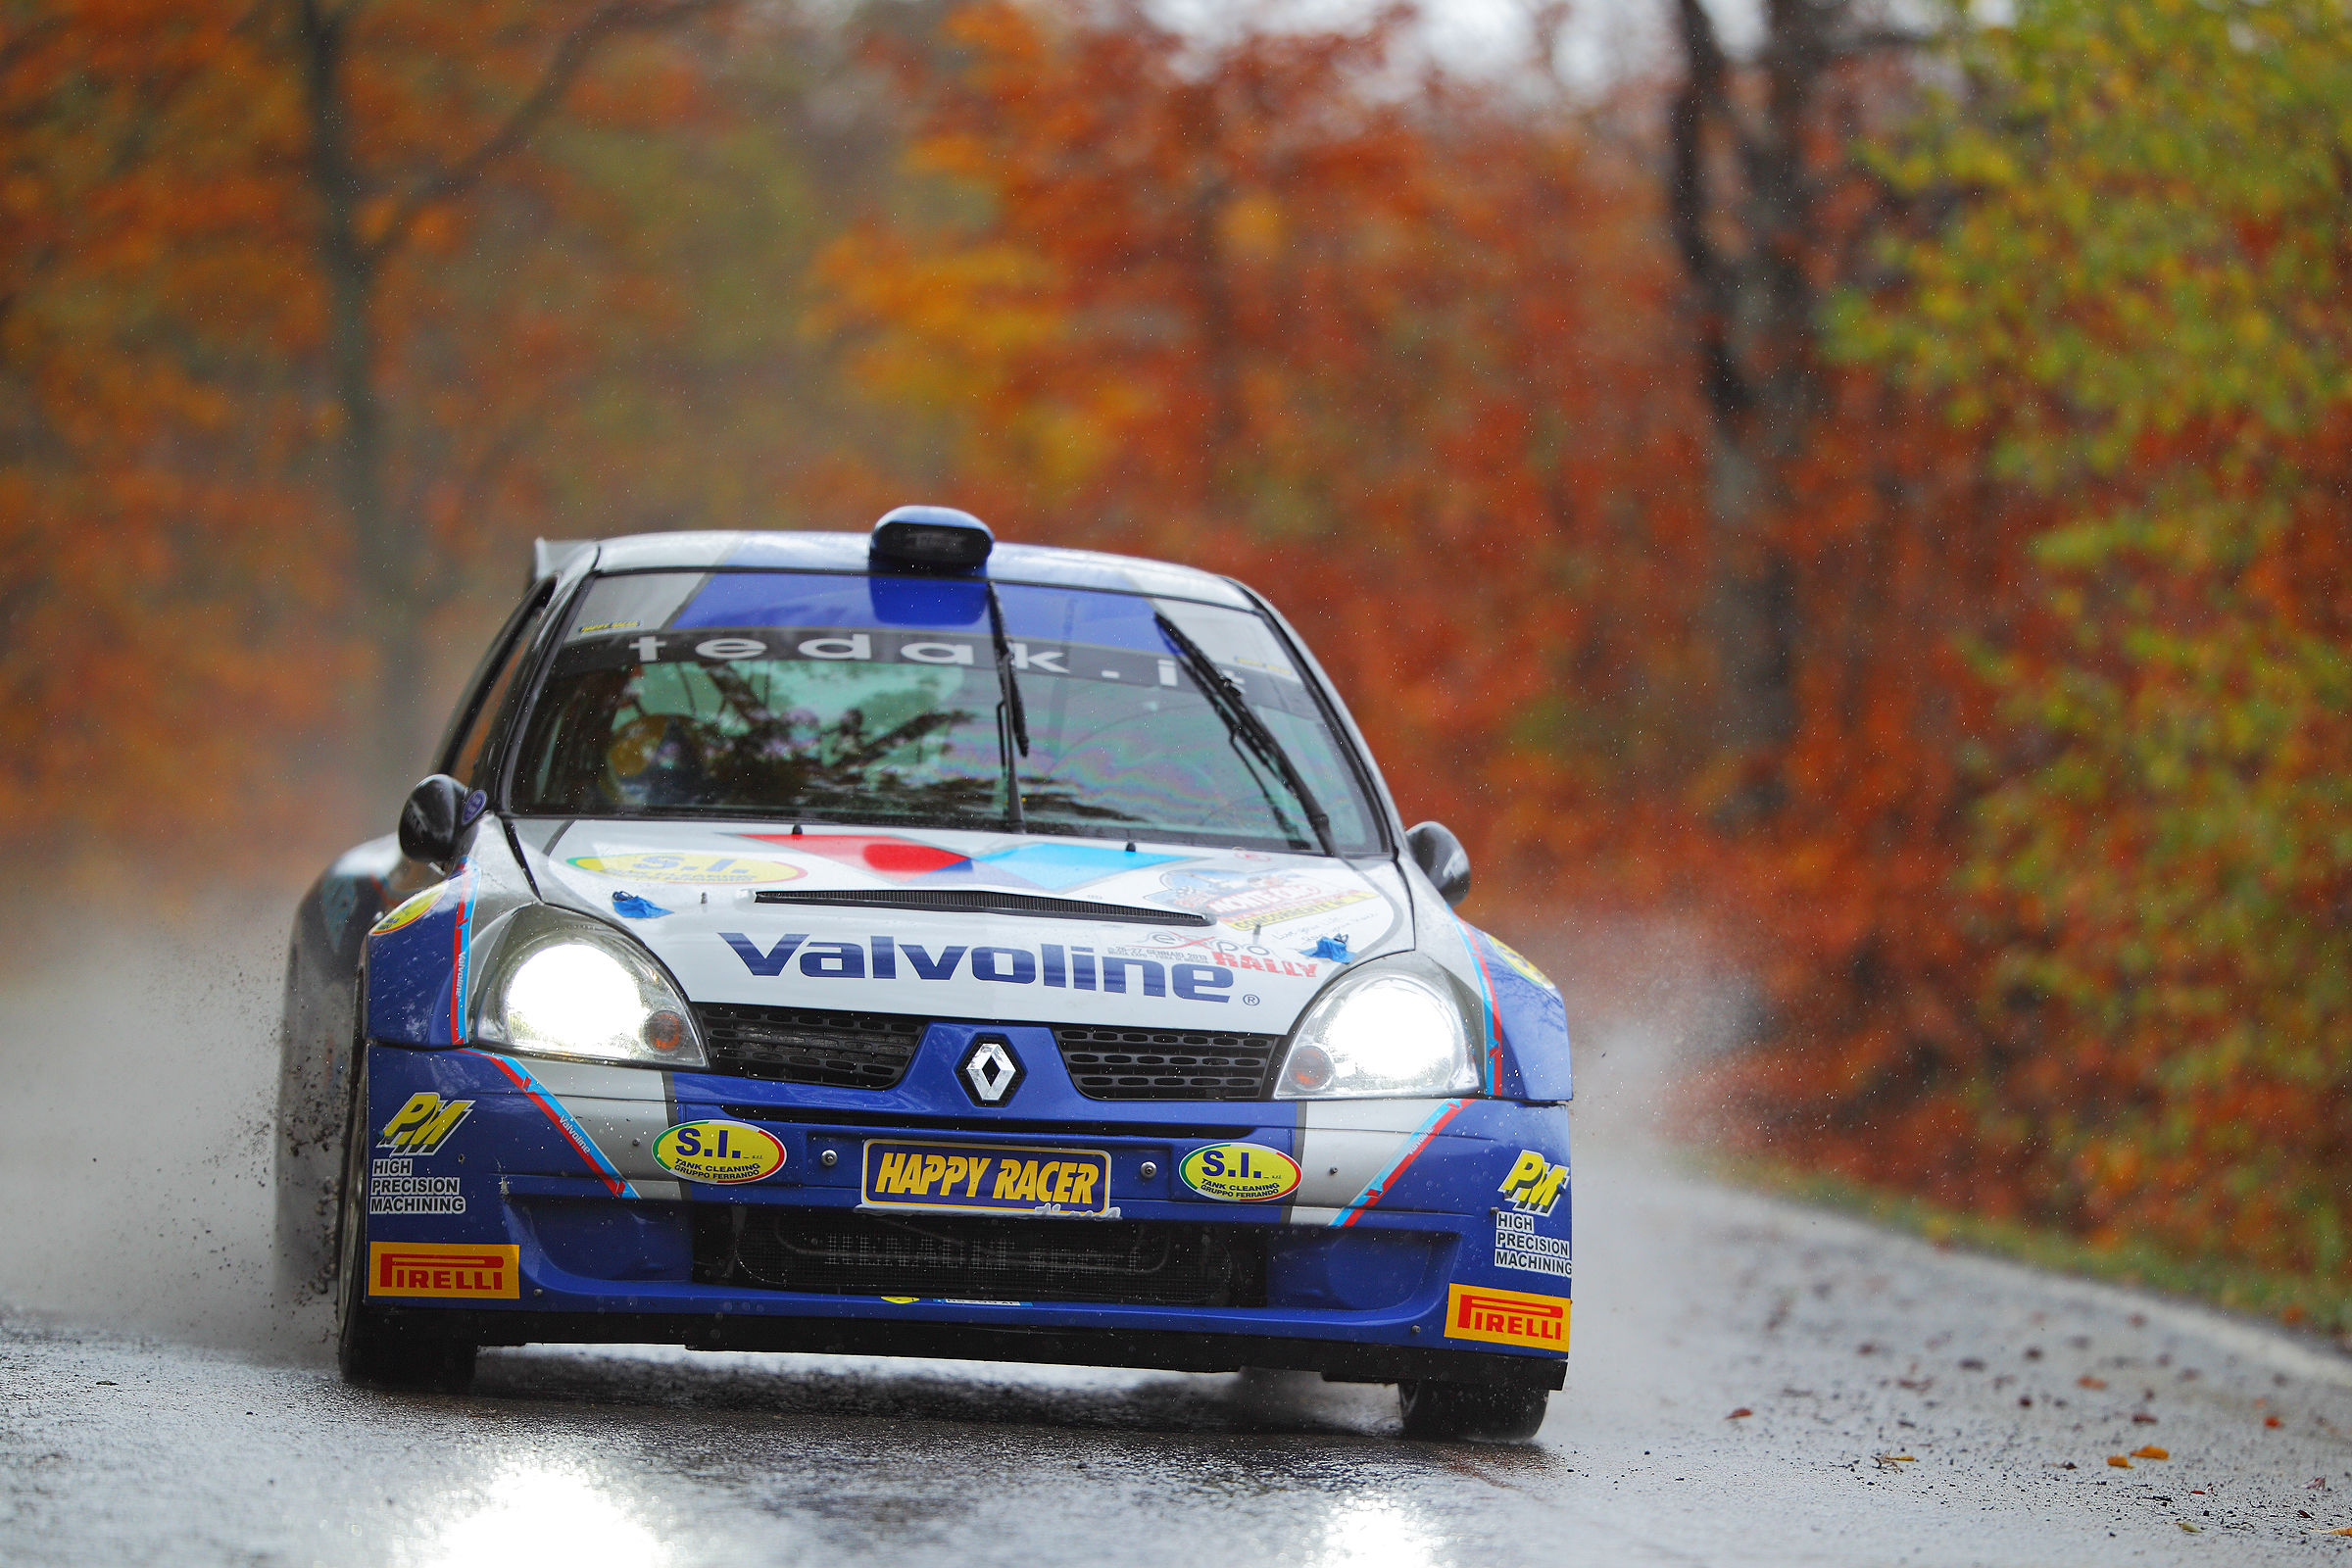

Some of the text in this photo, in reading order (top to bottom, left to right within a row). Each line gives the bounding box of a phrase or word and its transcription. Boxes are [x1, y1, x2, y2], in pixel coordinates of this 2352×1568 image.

[628, 633, 1246, 693] tedak.i
[632, 856, 750, 875] S.I.
[716, 931, 1234, 1004] Valvoline
[1212, 951, 1318, 978] RALLY
[559, 1114, 591, 1155] Valvoline
[675, 1127, 741, 1159] S.I.
[372, 1159, 412, 1175] HIGH
[674, 1164, 760, 1180] GRUPPO FERRANDO
[675, 1157, 761, 1173] TANK CLEANING
[1201, 1150, 1262, 1179] S.I.
[371, 1178, 459, 1194] PRECISION
[874, 1152, 1100, 1204] HAPPY RACER
[1200, 1177, 1280, 1192] TANK CLEANING
[1200, 1184, 1279, 1199] GRUPPO FERRANDO
[369, 1197, 466, 1213] MACHINING
[1496, 1213, 1533, 1232] HIGH
[1496, 1232, 1569, 1256] PRECISION
[379, 1252, 505, 1291] PIRELLI
[1495, 1250, 1572, 1276] MACHINING
[1456, 1293, 1564, 1341] PIRELLI
